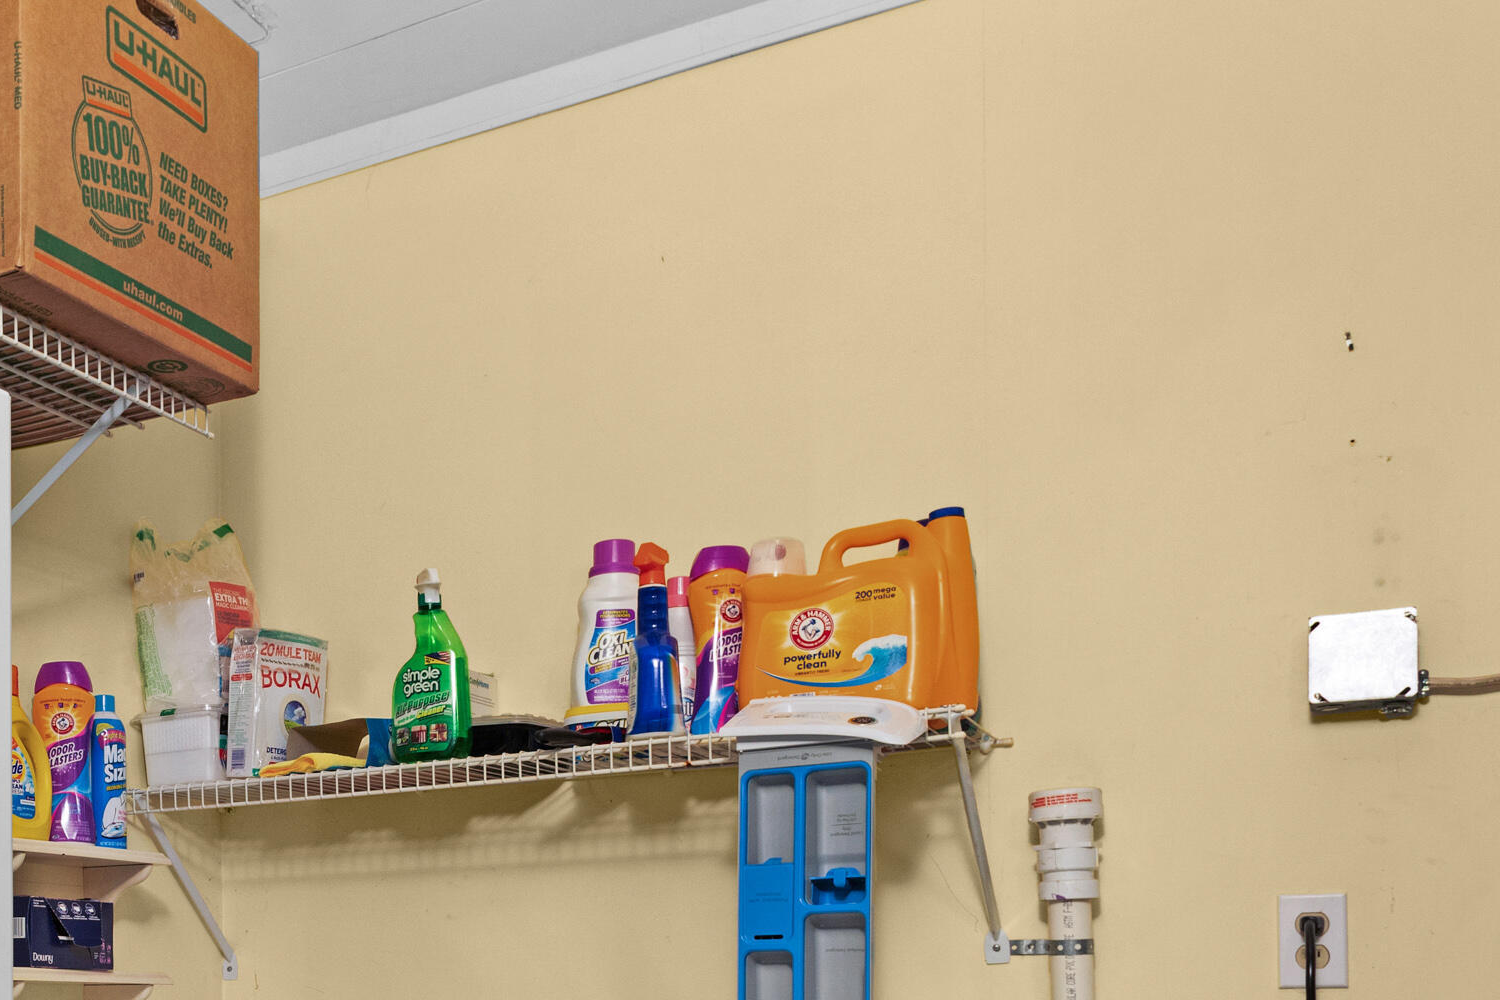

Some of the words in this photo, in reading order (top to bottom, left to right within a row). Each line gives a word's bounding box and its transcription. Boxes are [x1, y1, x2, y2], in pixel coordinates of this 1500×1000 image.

[114, 19, 202, 107] U-HAUL
[14, 86, 22, 110] MED
[85, 81, 129, 107] U-HAUL
[83, 112, 140, 166] 100%
[80, 153, 148, 198] BUY-BACK
[159, 152, 188, 184] NEED
[190, 173, 228, 212] BOXES?
[159, 175, 187, 206] TAKE
[188, 194, 228, 234] PLENTY!
[159, 197, 185, 228] We'll
[187, 216, 207, 245] Buy
[209, 231, 234, 260] Back
[158, 221, 176, 245] the
[178, 234, 213, 269] Extras.
[123, 280, 183, 322] uhaul.com
[215, 593, 237, 604] EXTRA
[855, 590, 872, 600] 200
[873, 592, 896, 600] value
[792, 618, 802, 636] ARM
[807, 610, 832, 631] HAMMER
[600, 632, 625, 649] OXI
[260, 642, 275, 657] 20
[276, 645, 302, 659] MULE
[303, 648, 322, 664] TEAM
[784, 649, 841, 665] powerfully
[402, 666, 440, 683] simple
[797, 661, 827, 670] clean
[260, 665, 321, 699] BORAX
[403, 680, 439, 698] green
[416, 705, 445, 719] Cleaner
[50, 750, 82, 767] LASTERS
[51, 743, 74, 758] ODOR
[12, 760, 23, 774] de
[32, 952, 53, 964] Downy
[1065, 972, 1076, 985] CORE
